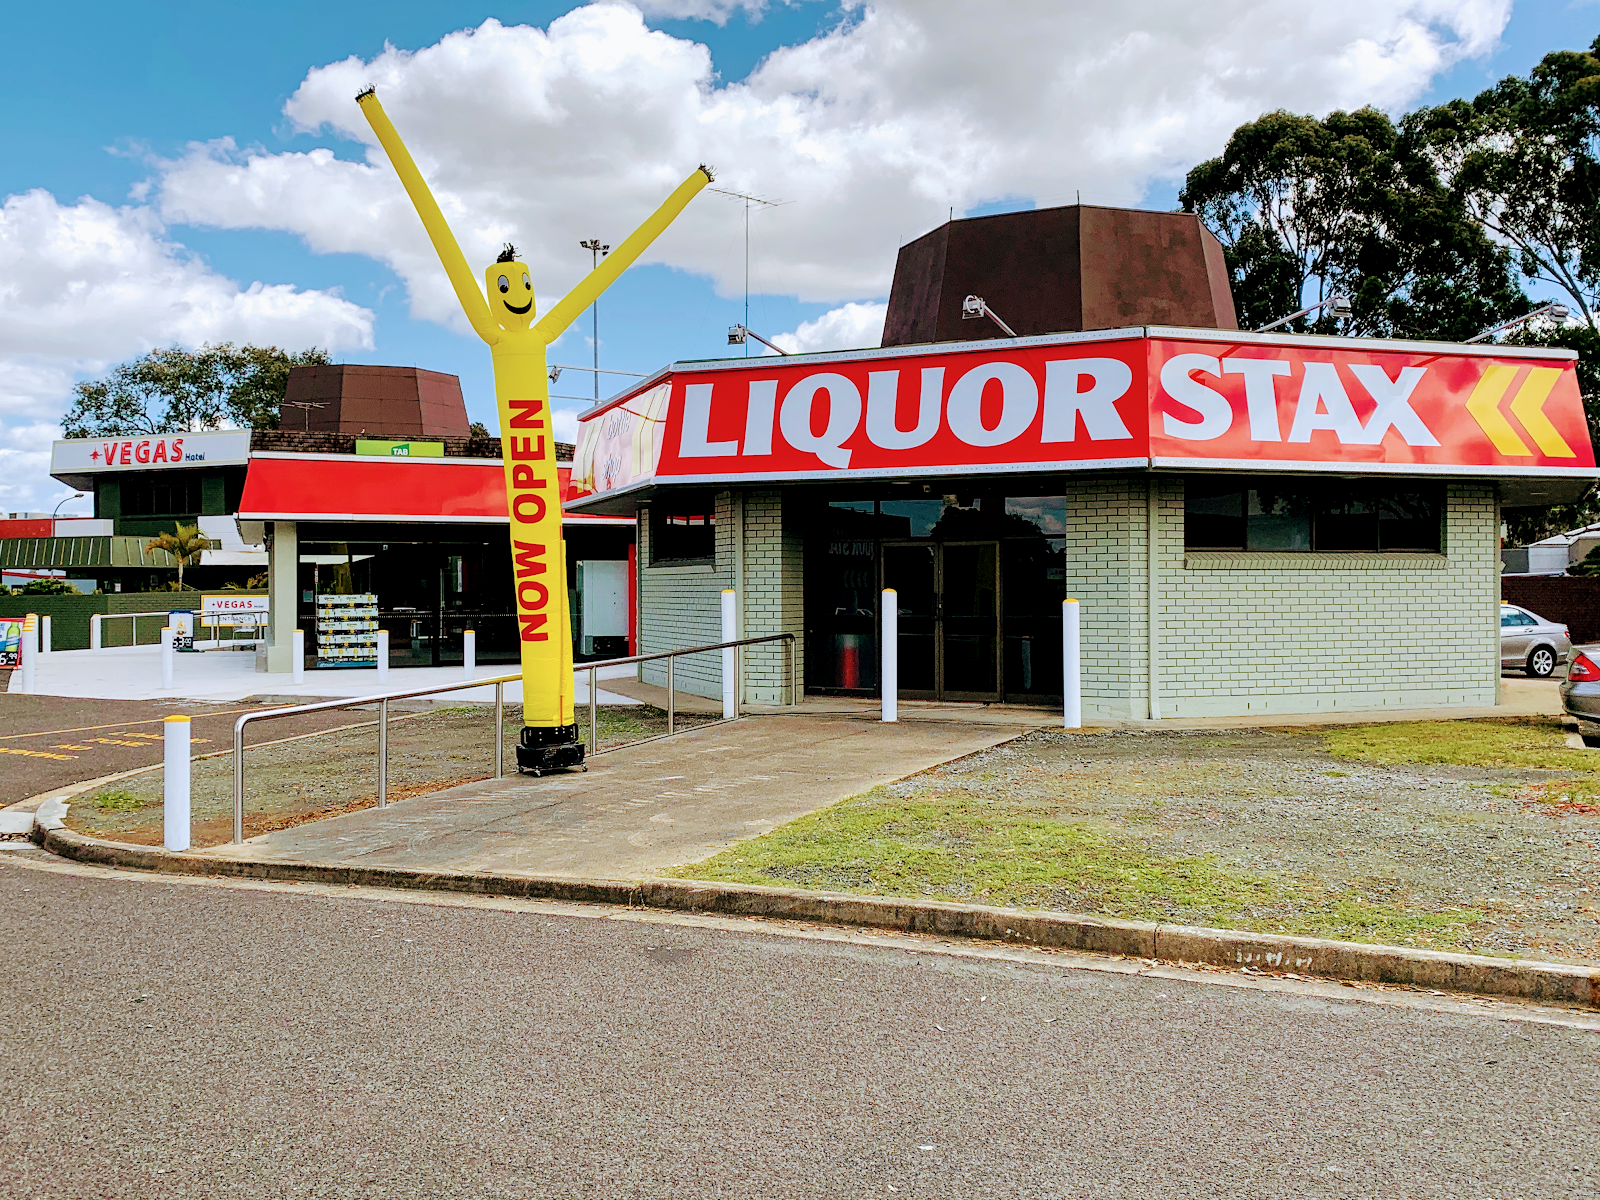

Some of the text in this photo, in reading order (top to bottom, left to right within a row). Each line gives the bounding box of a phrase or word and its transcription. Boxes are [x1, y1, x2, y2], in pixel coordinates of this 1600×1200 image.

[607, 407, 632, 441] bottle
[678, 353, 1442, 469] LIQUOR STAX
[103, 438, 206, 465] VEGAS Hotel
[392, 448, 409, 456] TAB
[508, 400, 549, 642] NOW OPEN
[216, 600, 253, 609] VEGAS
